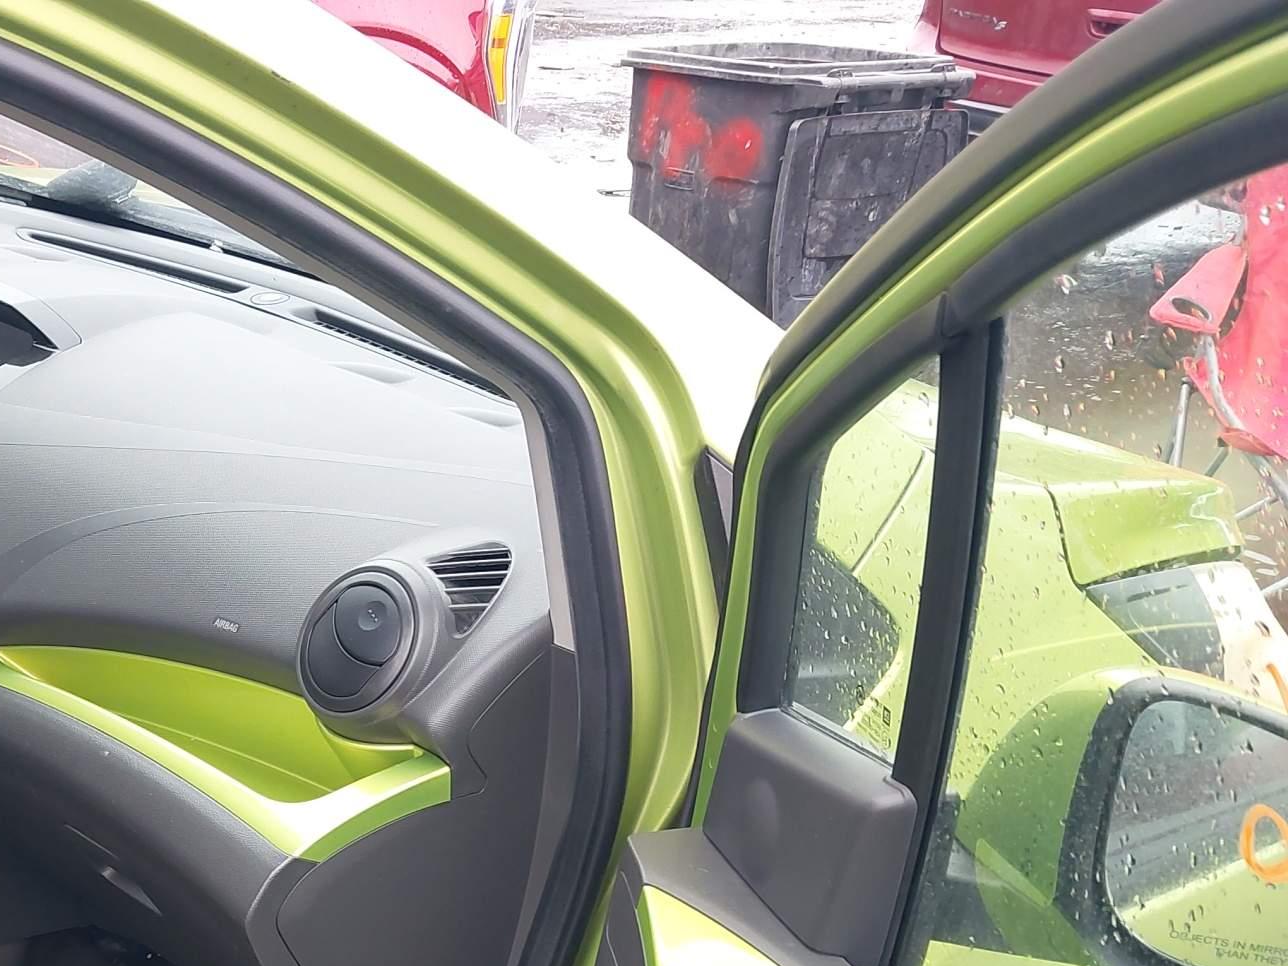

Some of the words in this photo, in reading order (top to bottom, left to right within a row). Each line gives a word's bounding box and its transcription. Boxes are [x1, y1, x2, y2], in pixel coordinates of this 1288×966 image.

[214, 617, 239, 633] AIRBAG
[1232, 940, 1246, 949] IN
[1215, 947, 1249, 960] THAN
